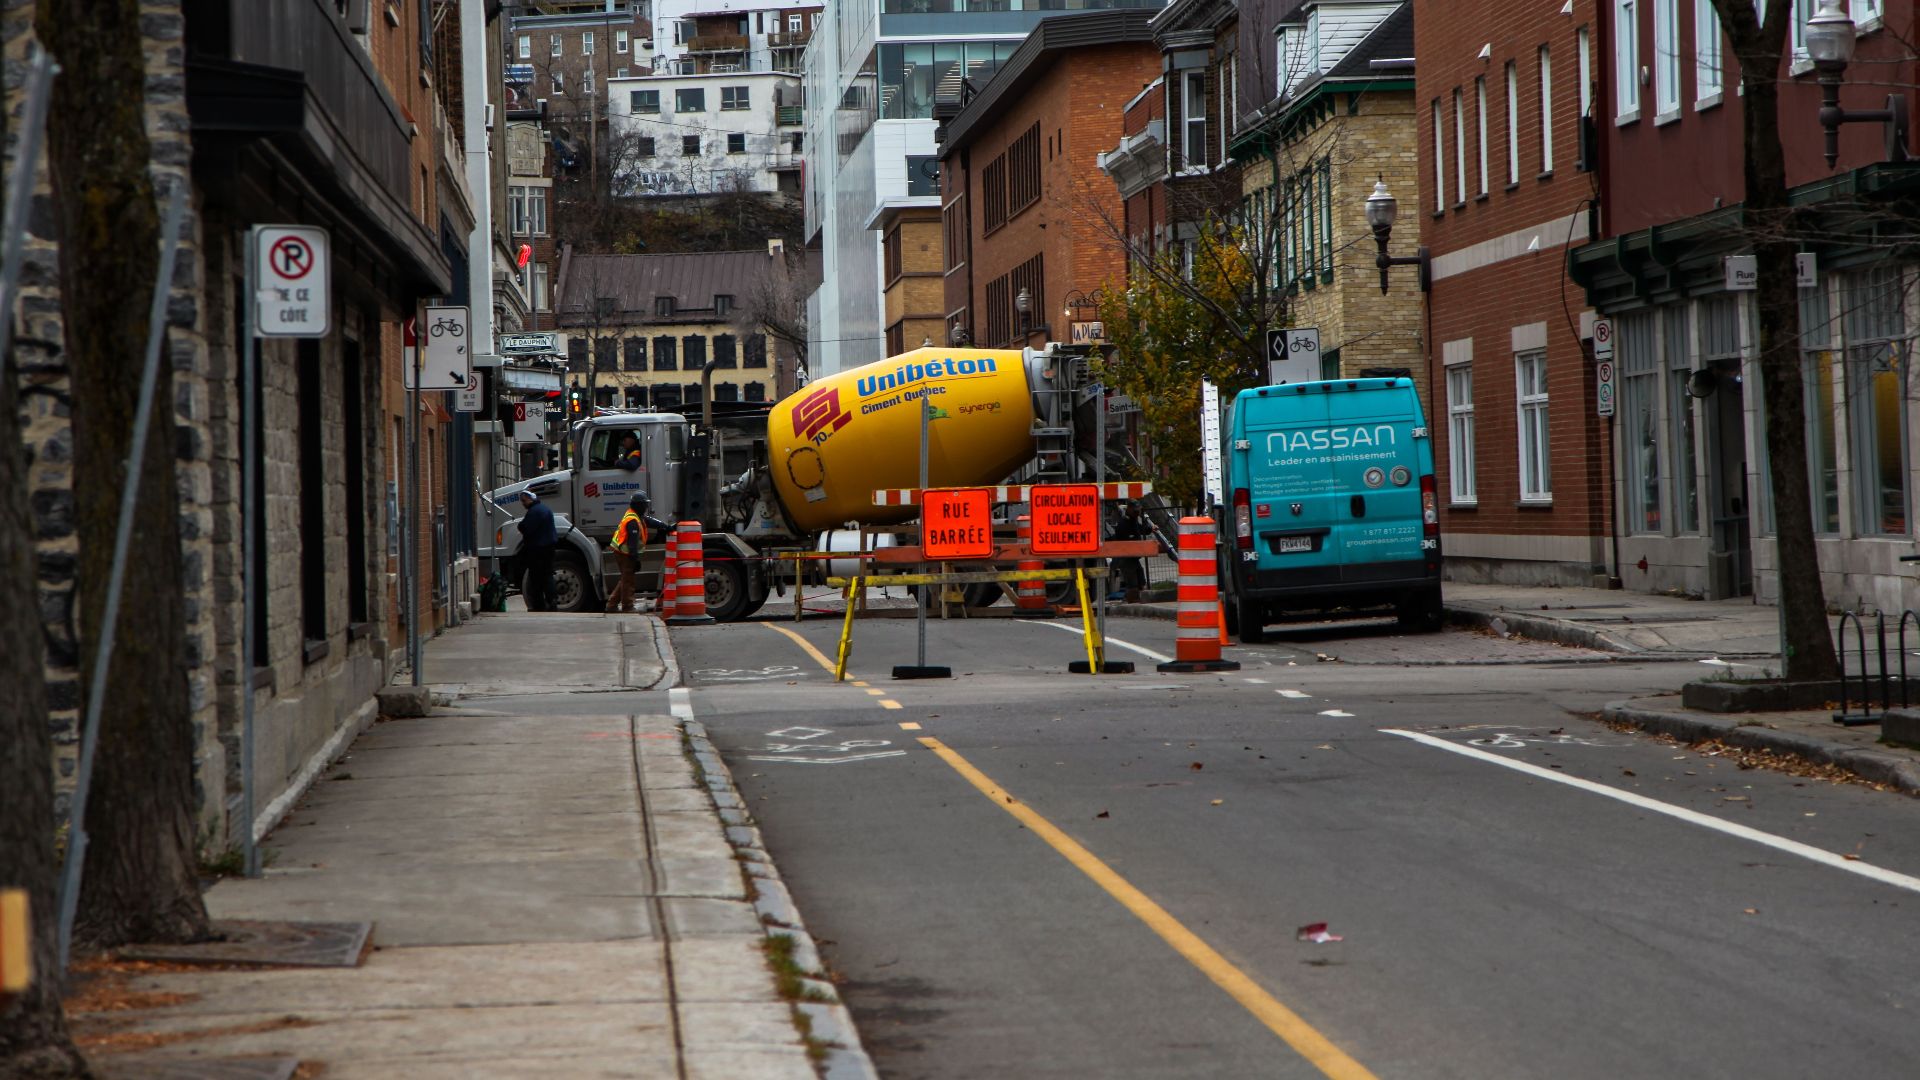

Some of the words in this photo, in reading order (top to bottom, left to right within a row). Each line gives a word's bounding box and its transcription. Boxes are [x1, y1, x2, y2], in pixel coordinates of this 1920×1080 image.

[1736, 270, 1756, 279] Rue
[857, 357, 997, 397] Unibéton
[861, 396, 903, 415] Ciment
[904, 386, 947, 403] Québec
[811, 431, 828, 447] 70
[1266, 425, 1396, 453] NASSAN
[1268, 458, 1303, 467] Leader
[1320, 450, 1397, 463] assainissement
[602, 482, 640, 490] Unibéton
[1035, 494, 1094, 507] CIRCULATION
[943, 502, 971, 518] RUE
[1047, 513, 1081, 525] LOCALE
[930, 525, 985, 545] BARRÉE
[1038, 531, 1092, 544] SEULEMENT
[1346, 536, 1417, 548] groupenassan.com
